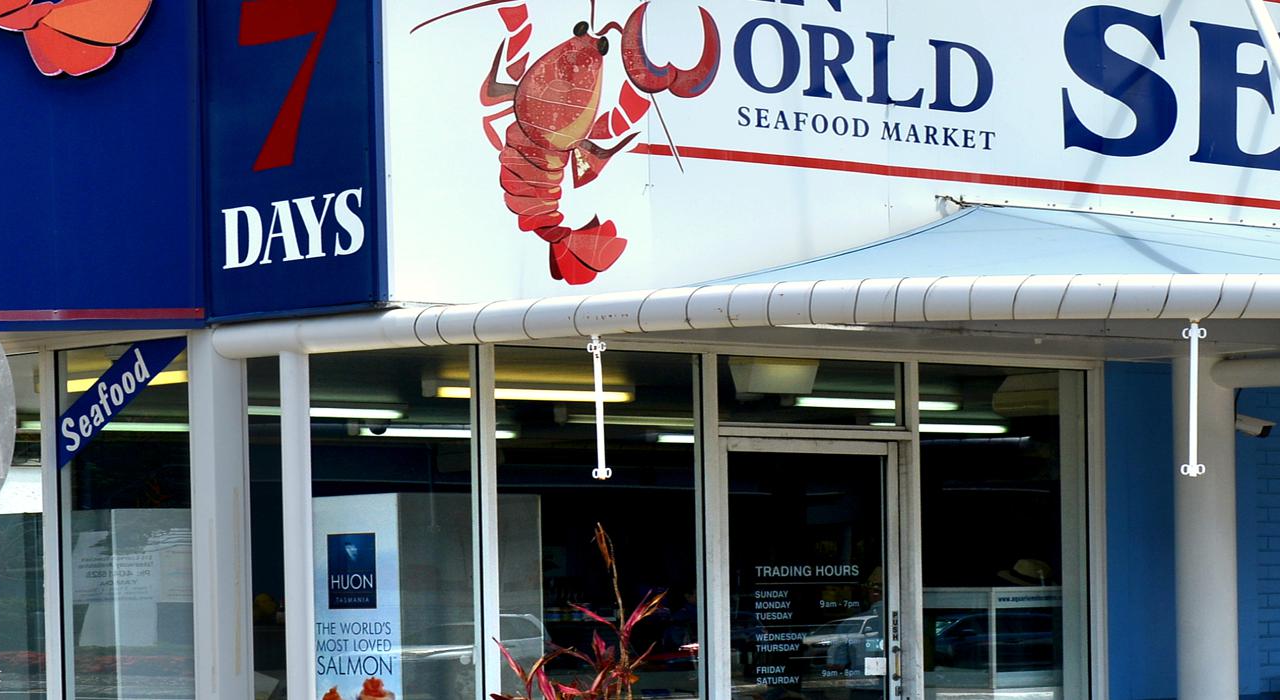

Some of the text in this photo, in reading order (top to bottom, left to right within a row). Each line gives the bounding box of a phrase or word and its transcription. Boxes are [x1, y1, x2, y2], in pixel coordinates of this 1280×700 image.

[237, 0, 337, 172] 7
[738, 106, 996, 150] SEAFOOD MARKET
[221, 187, 365, 270] DAYS
[61, 347, 151, 452] Seafood
[755, 565, 860, 577] TRADING HOURS
[330, 573, 374, 590] HUON
[755, 590, 789, 599] SUNDAY
[755, 601, 791, 609] MONDAY
[819, 600, 838, 608] 9am
[844, 601, 860, 609] 7pm
[755, 612, 793, 621] TUESDAY
[316, 621, 392, 635] THE WORLD'S
[891, 611, 899, 641] PUSH
[756, 632, 808, 641] WEDNESDAY
[316, 638, 392, 652] MOST LOVED
[756, 644, 801, 652] THURSDAY
[317, 655, 394, 676] SALMON
[756, 665, 786, 674] FRIDAY
[756, 676, 800, 685] SATURDAY
[821, 669, 838, 677] 9am
